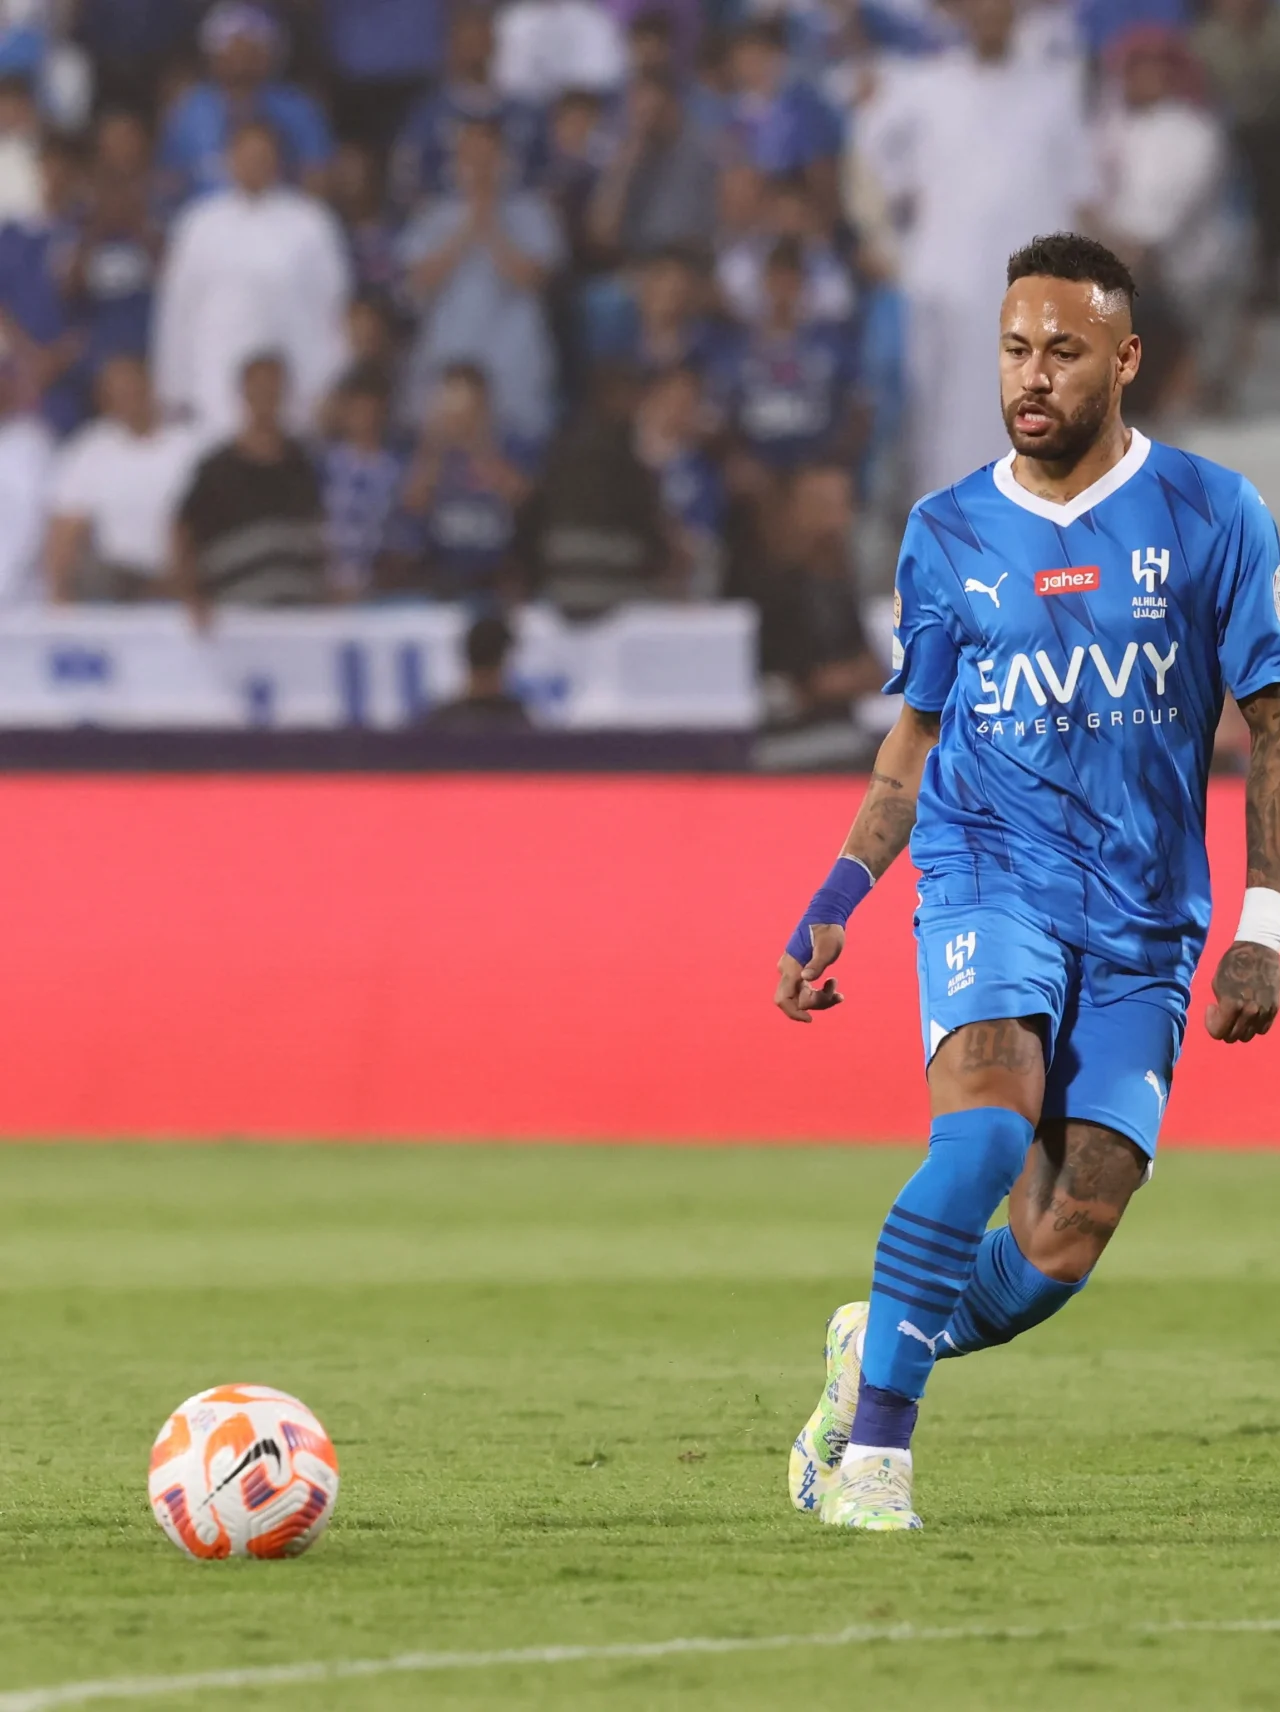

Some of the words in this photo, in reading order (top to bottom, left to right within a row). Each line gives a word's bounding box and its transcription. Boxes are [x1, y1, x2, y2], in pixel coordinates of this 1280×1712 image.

[1131, 596, 1168, 608] ALHILAL
[1133, 607, 1166, 619] الهلال
[973, 641, 1179, 715] SAVVY
[976, 716, 1070, 737] GAMES
[1087, 706, 1178, 729] GROUP
